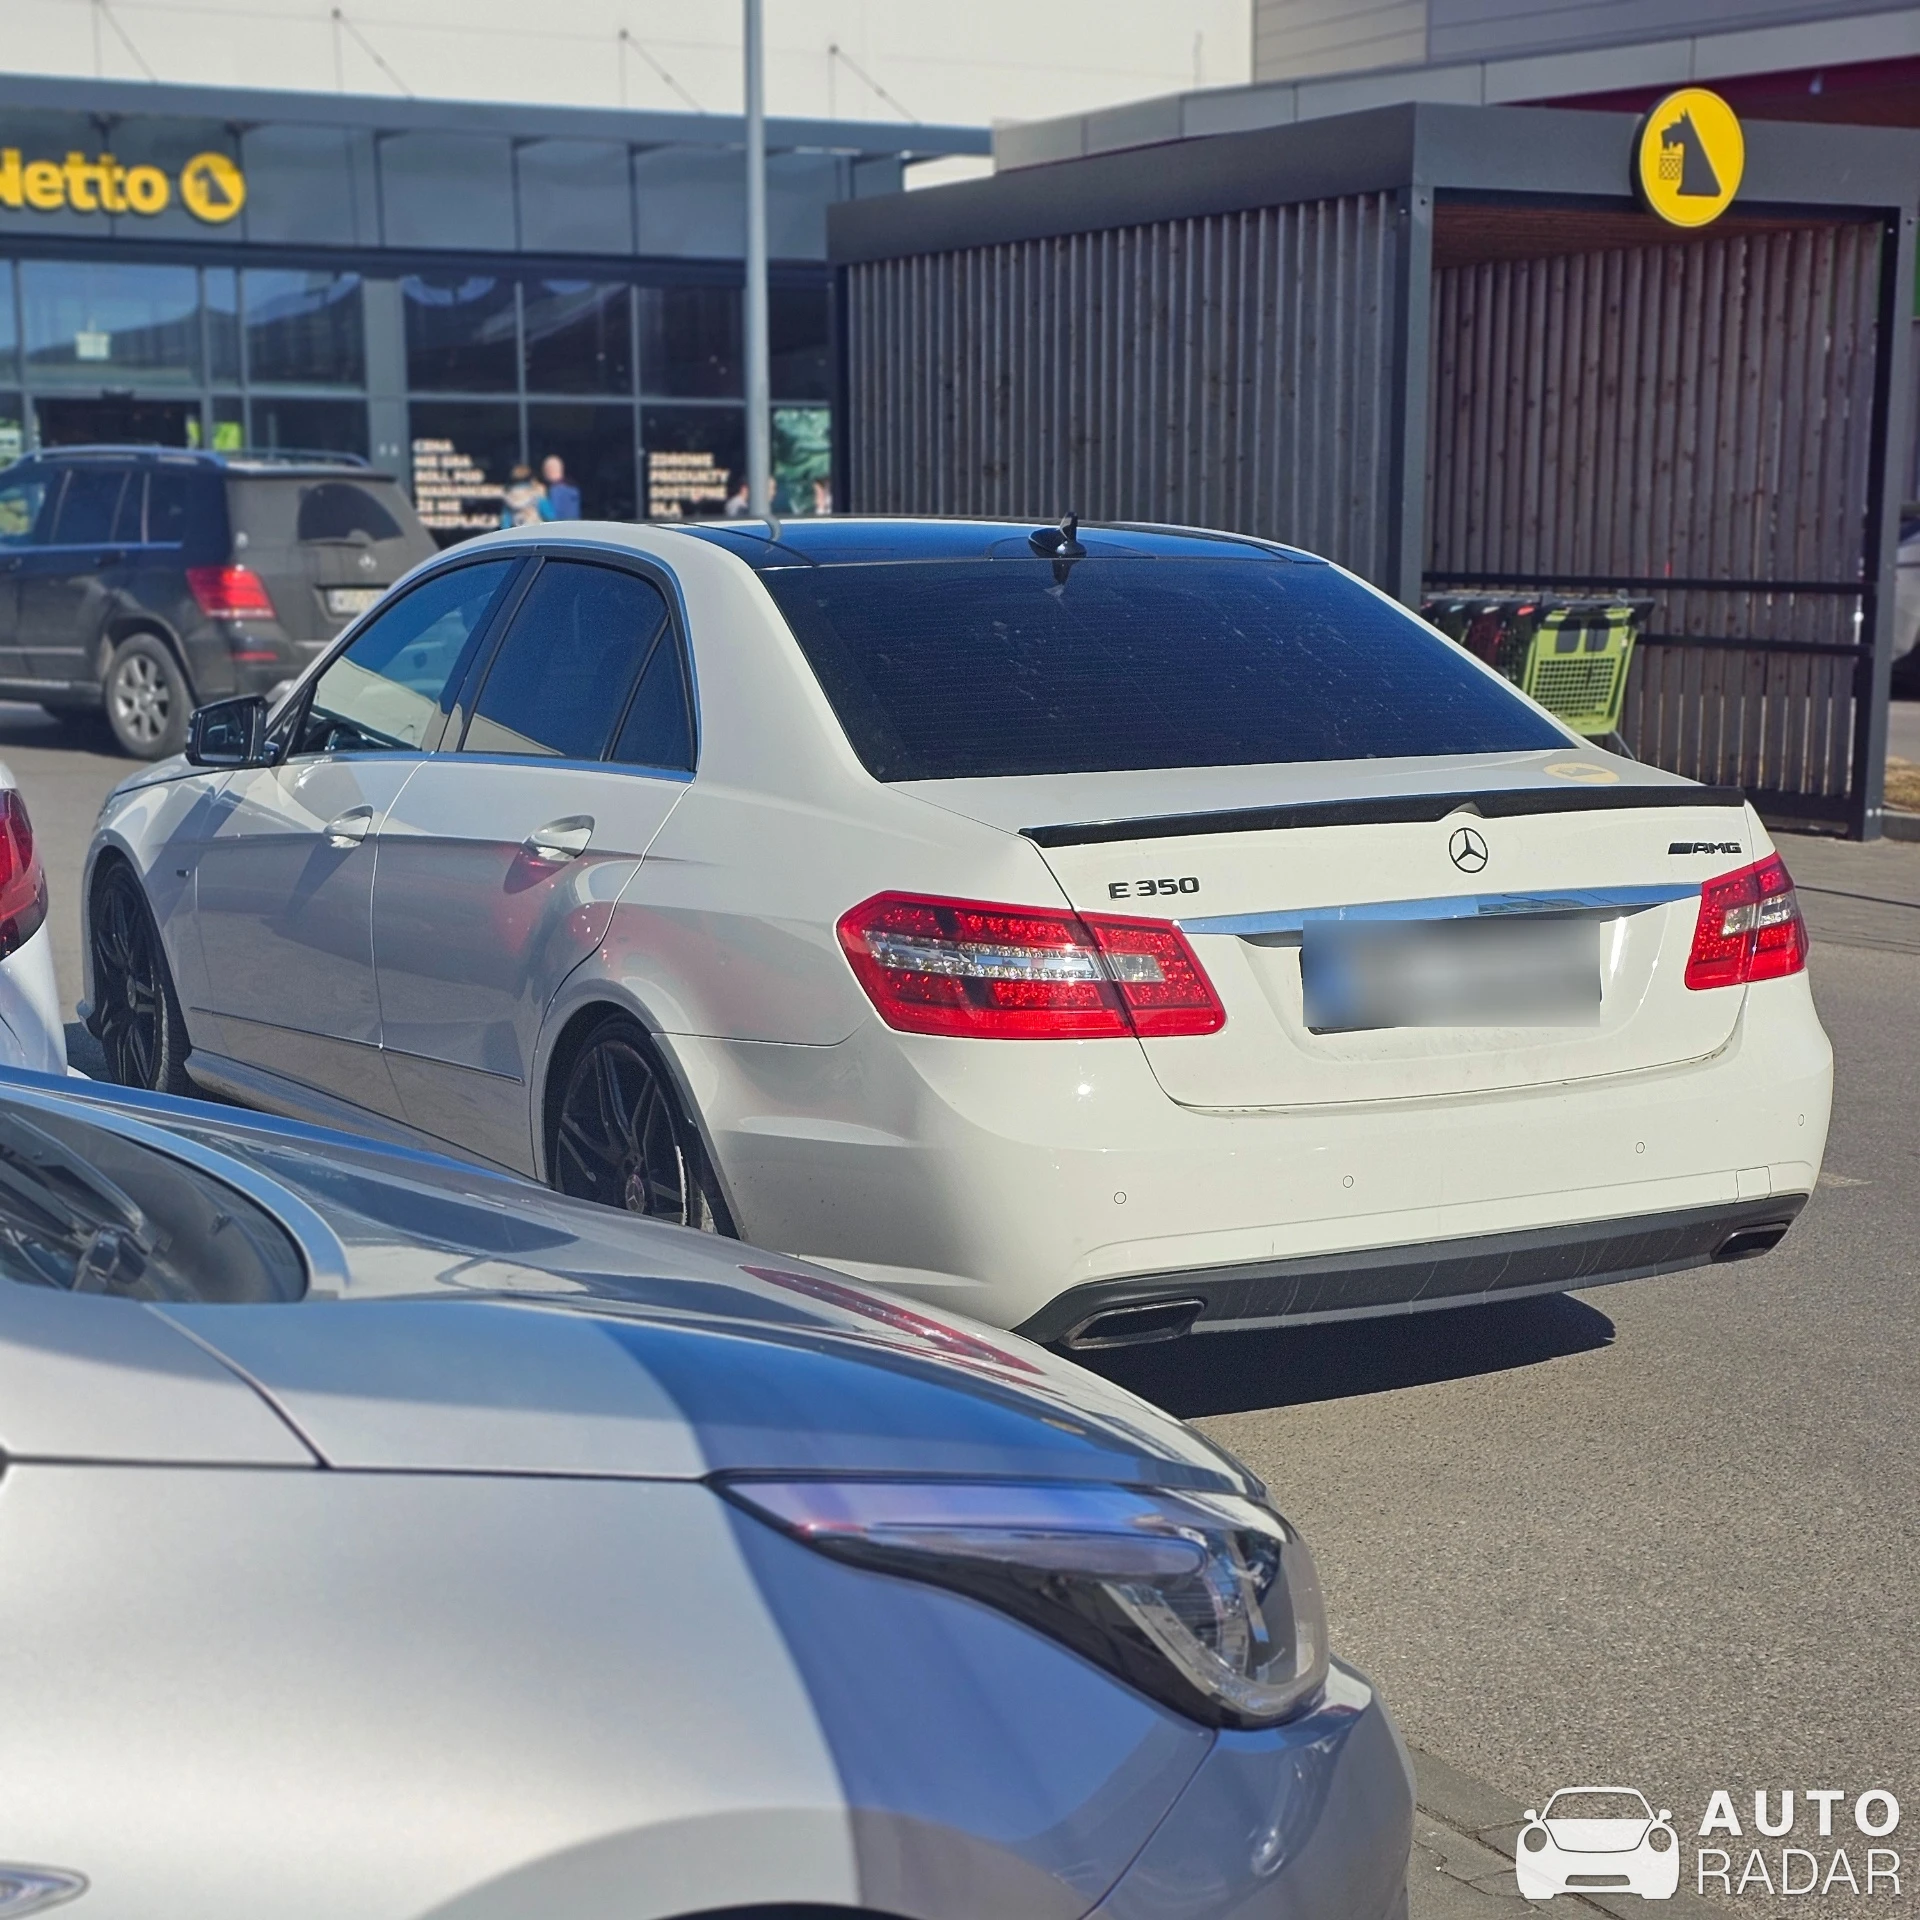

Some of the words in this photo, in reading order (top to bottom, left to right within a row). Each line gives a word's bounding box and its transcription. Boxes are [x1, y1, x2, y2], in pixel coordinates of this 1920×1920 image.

[1692, 842, 1742, 854] AMG
[1108, 882, 1131, 899] E
[1135, 877, 1200, 896] 350
